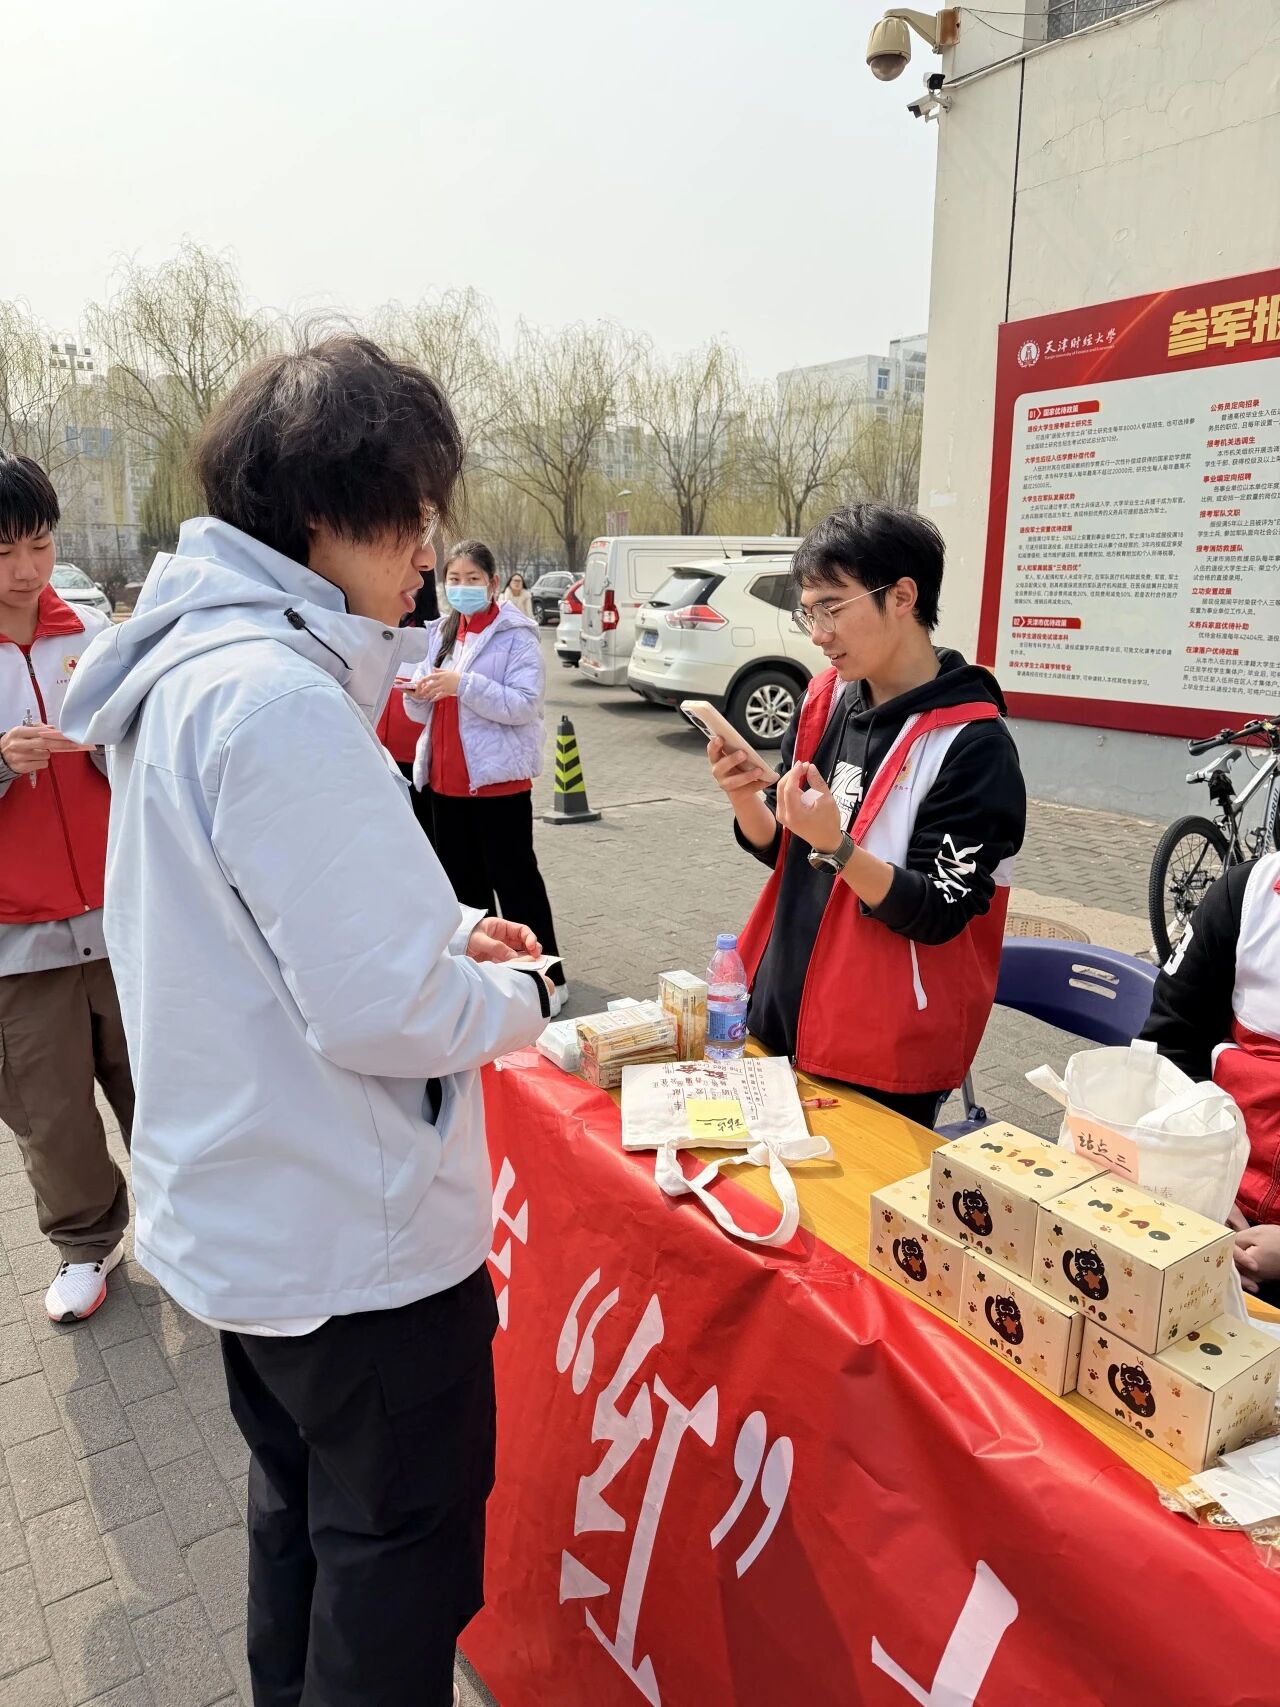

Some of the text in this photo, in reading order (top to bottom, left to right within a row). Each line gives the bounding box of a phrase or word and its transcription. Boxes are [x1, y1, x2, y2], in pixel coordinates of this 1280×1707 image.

[1043, 405, 1079, 417] 国家优待政策
[1211, 399, 1260, 412] 公务员定向招录
[1207, 436, 1256, 448] 报考机关选调生
[1203, 472, 1252, 483] 事业编定向招聘
[1200, 509, 1240, 518] 报考军队文职
[1196, 544, 1243, 553] 报考消防救援队
[1191, 587, 1232, 595] 立功安置政策
[1188, 621, 1249, 630] 义务兵家庭优待补助
[1186, 647, 1239, 656] 在津落户优待政策
[696, 1117, 744, 1132] 站点二
[1078, 1132, 1132, 1173] 站点三
